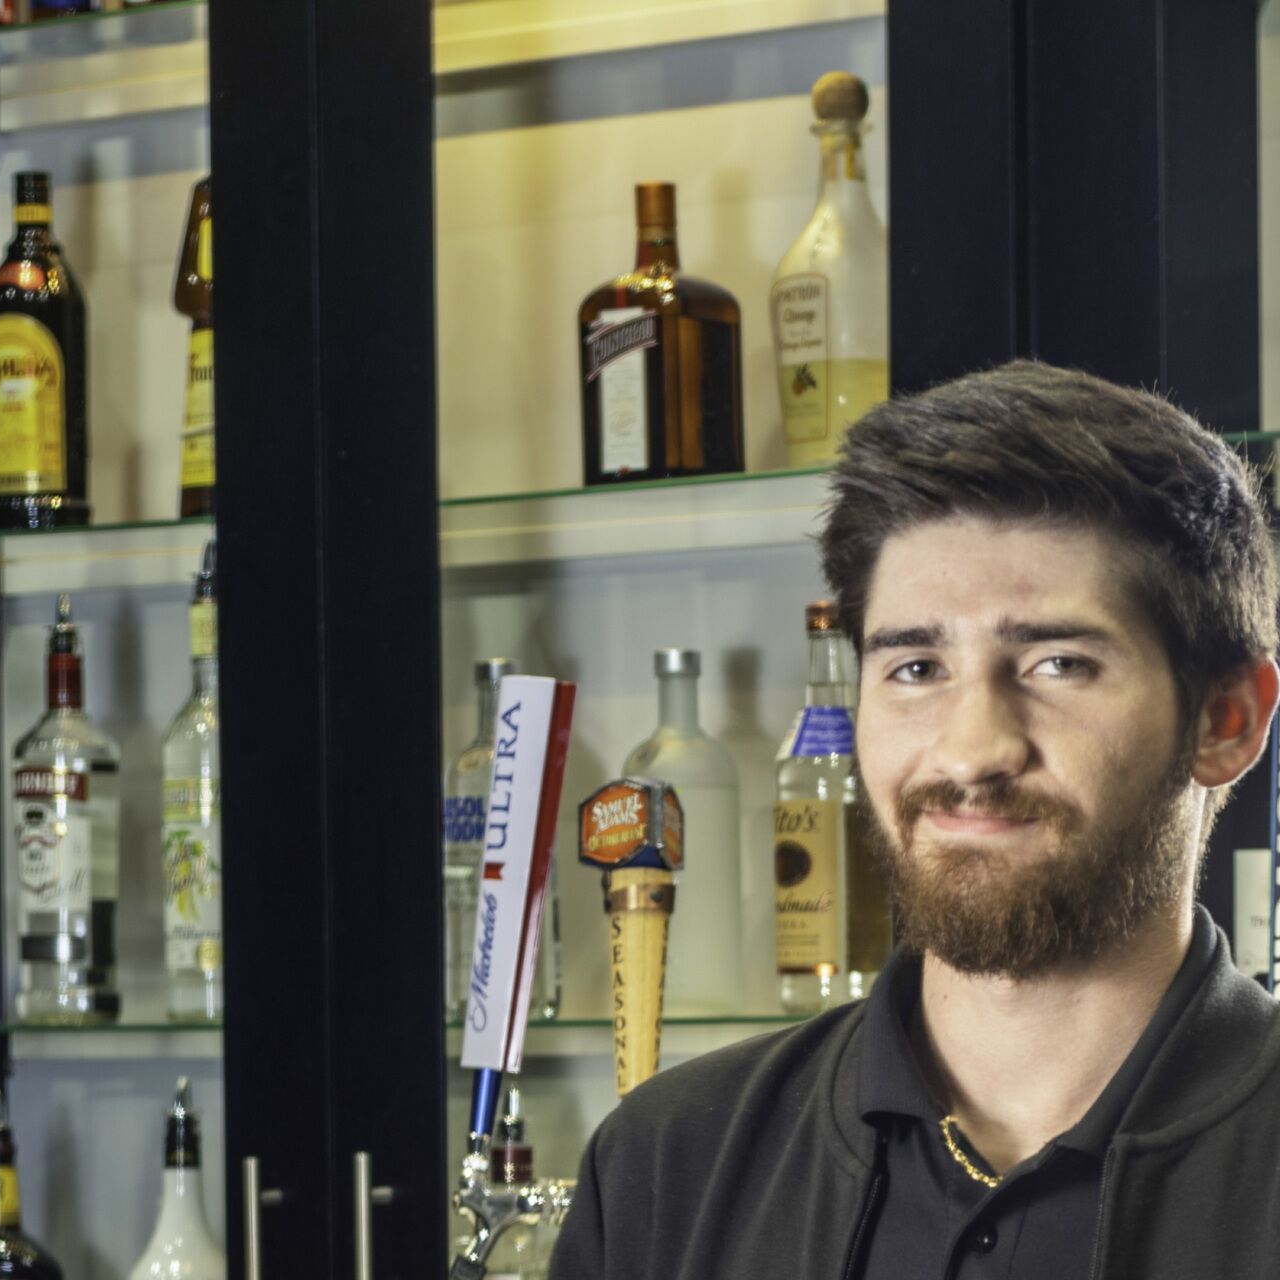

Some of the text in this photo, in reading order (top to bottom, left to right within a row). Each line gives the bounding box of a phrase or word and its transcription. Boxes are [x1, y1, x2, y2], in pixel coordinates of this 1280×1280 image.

[469, 700, 521, 1033] Michelob ULTRA
[611, 917, 626, 1088] SEASONAL
